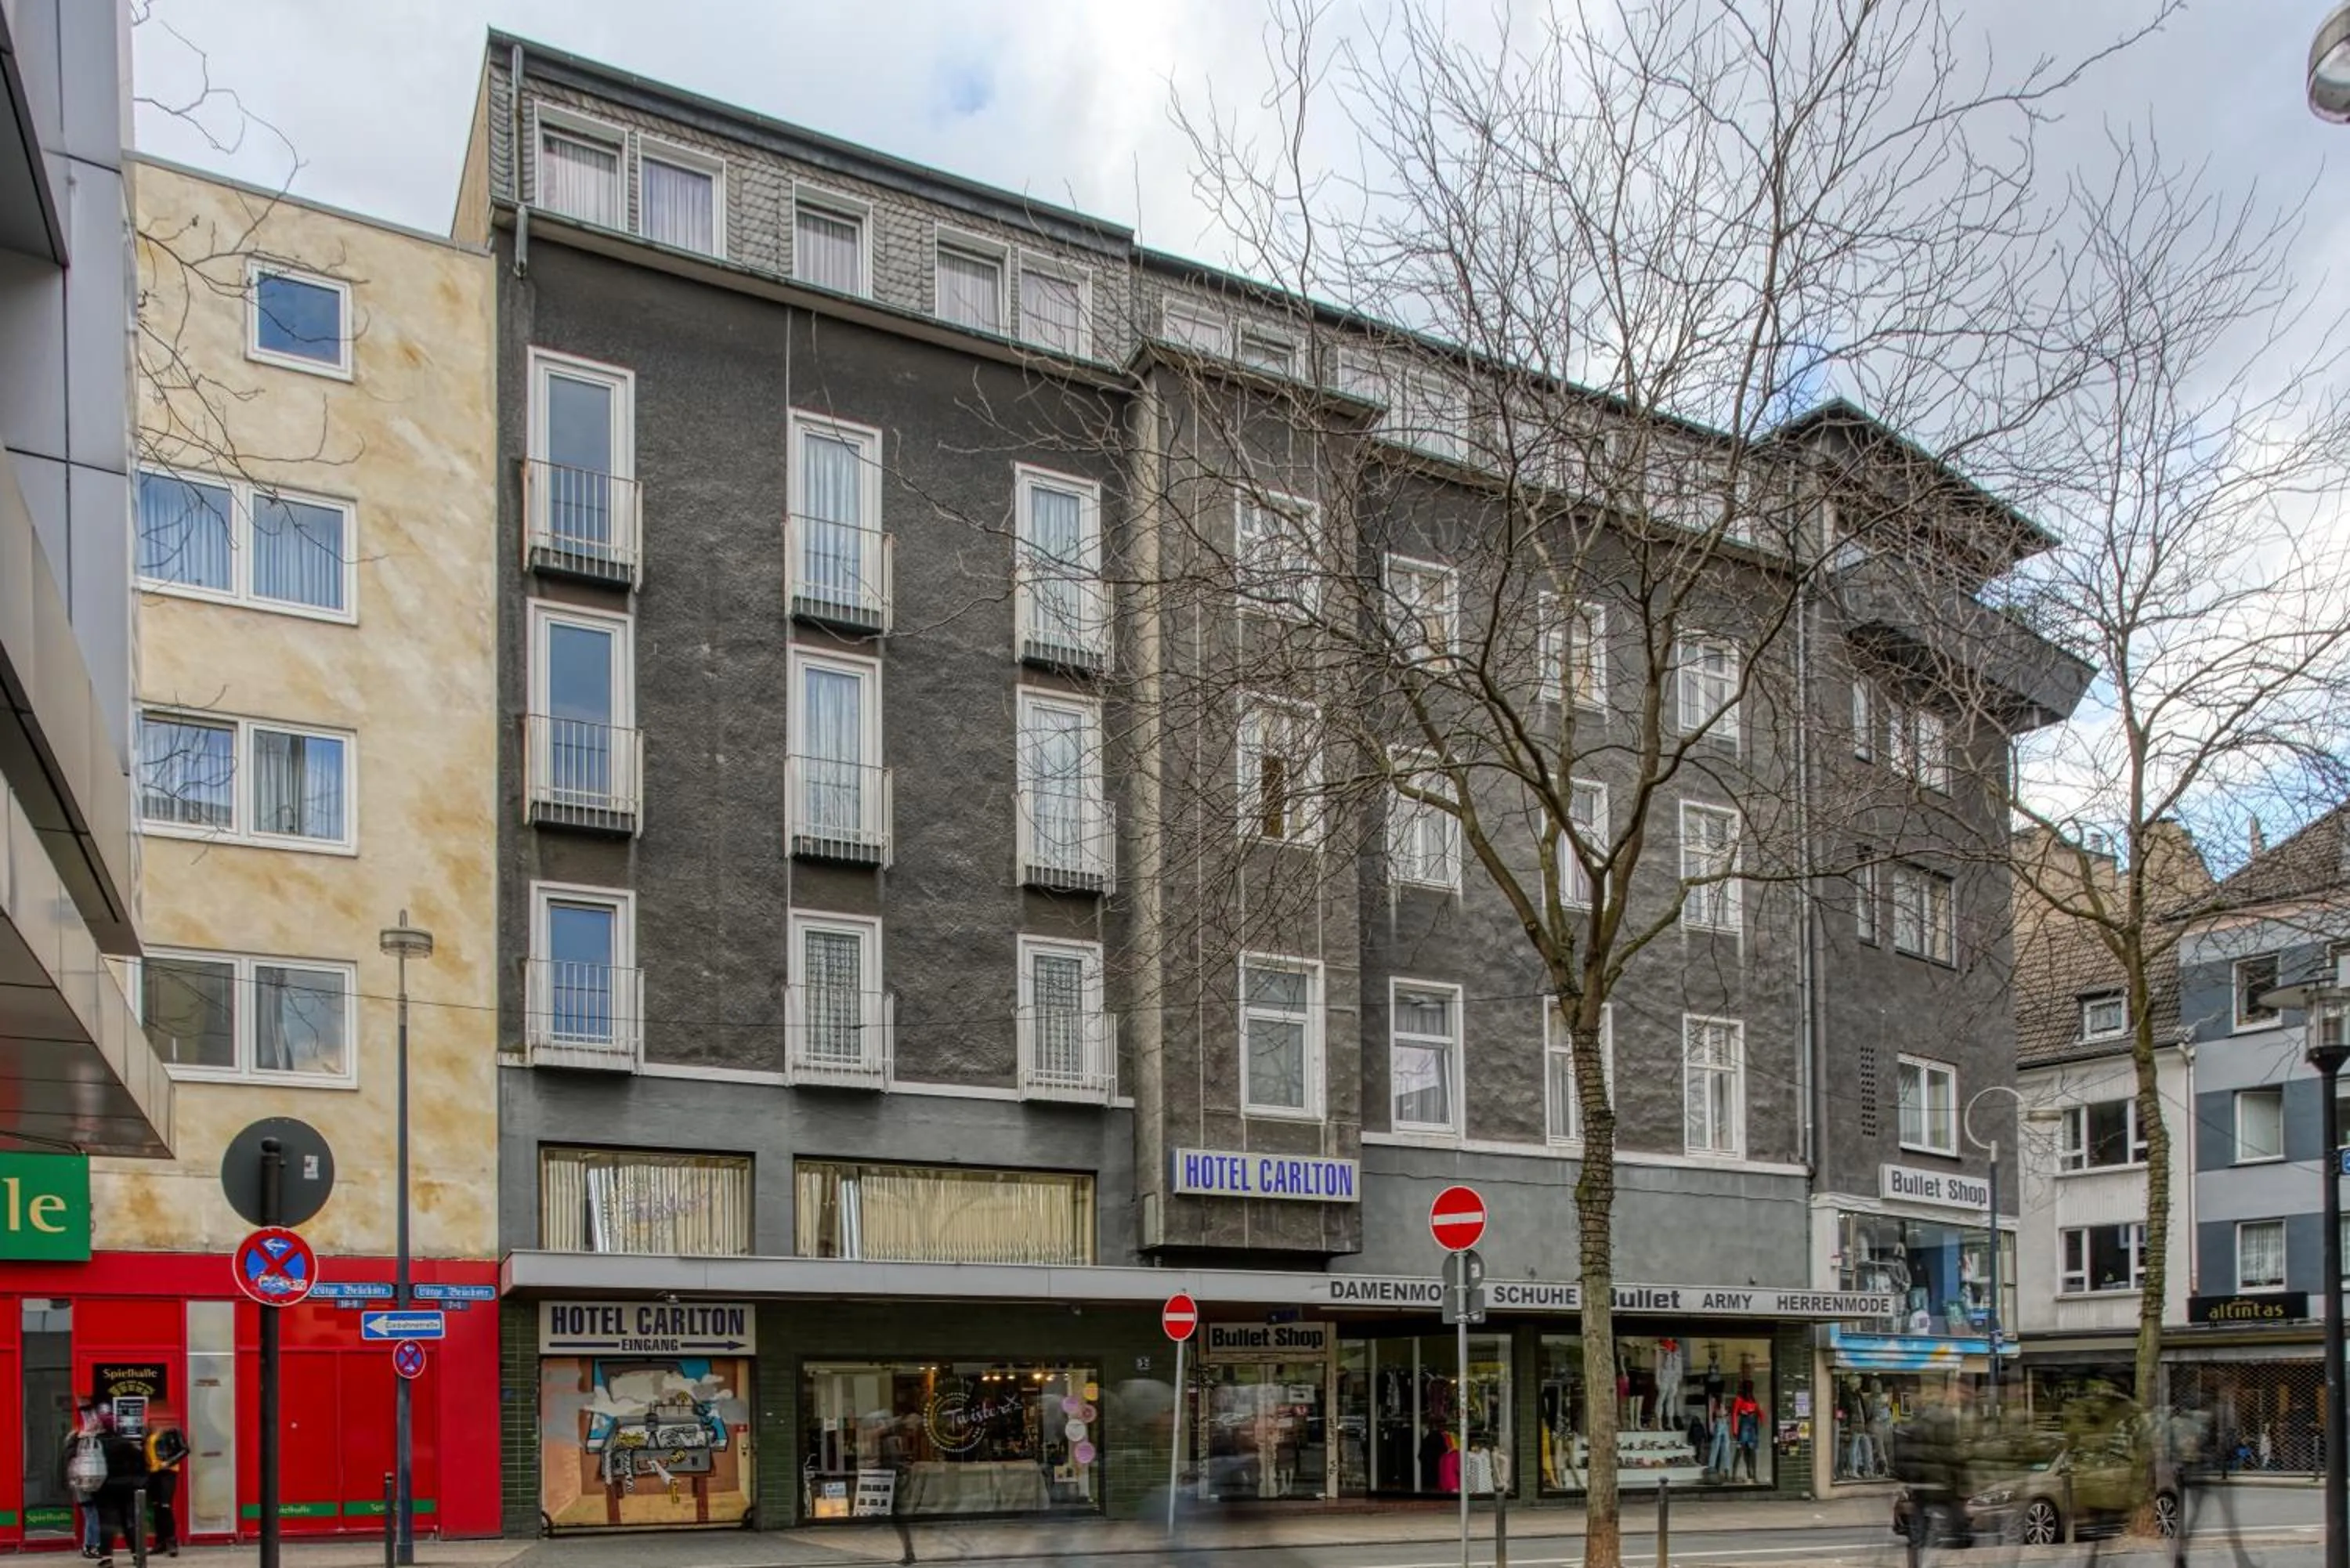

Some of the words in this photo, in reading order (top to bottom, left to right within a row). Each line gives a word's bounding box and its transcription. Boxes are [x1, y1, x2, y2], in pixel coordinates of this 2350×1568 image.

[1185, 1154, 1251, 1191] HOTEL
[1259, 1158, 1353, 1196] CARLTON
[1891, 1170, 1941, 1198] Bullet
[1947, 1179, 1987, 1206] Shop
[1329, 1281, 1448, 1302] DAMENMO
[1493, 1285, 1578, 1305] SCHUHE
[1702, 1293, 1753, 1310] ARMY
[1777, 1295, 1889, 1314] HERRENMODE
[551, 1306, 627, 1335] HOTEL
[636, 1306, 744, 1336] CARLTON
[621, 1339, 679, 1352] EINGANG
[1212, 1328, 1271, 1346] Bullet
[1274, 1328, 1324, 1349] Shop
